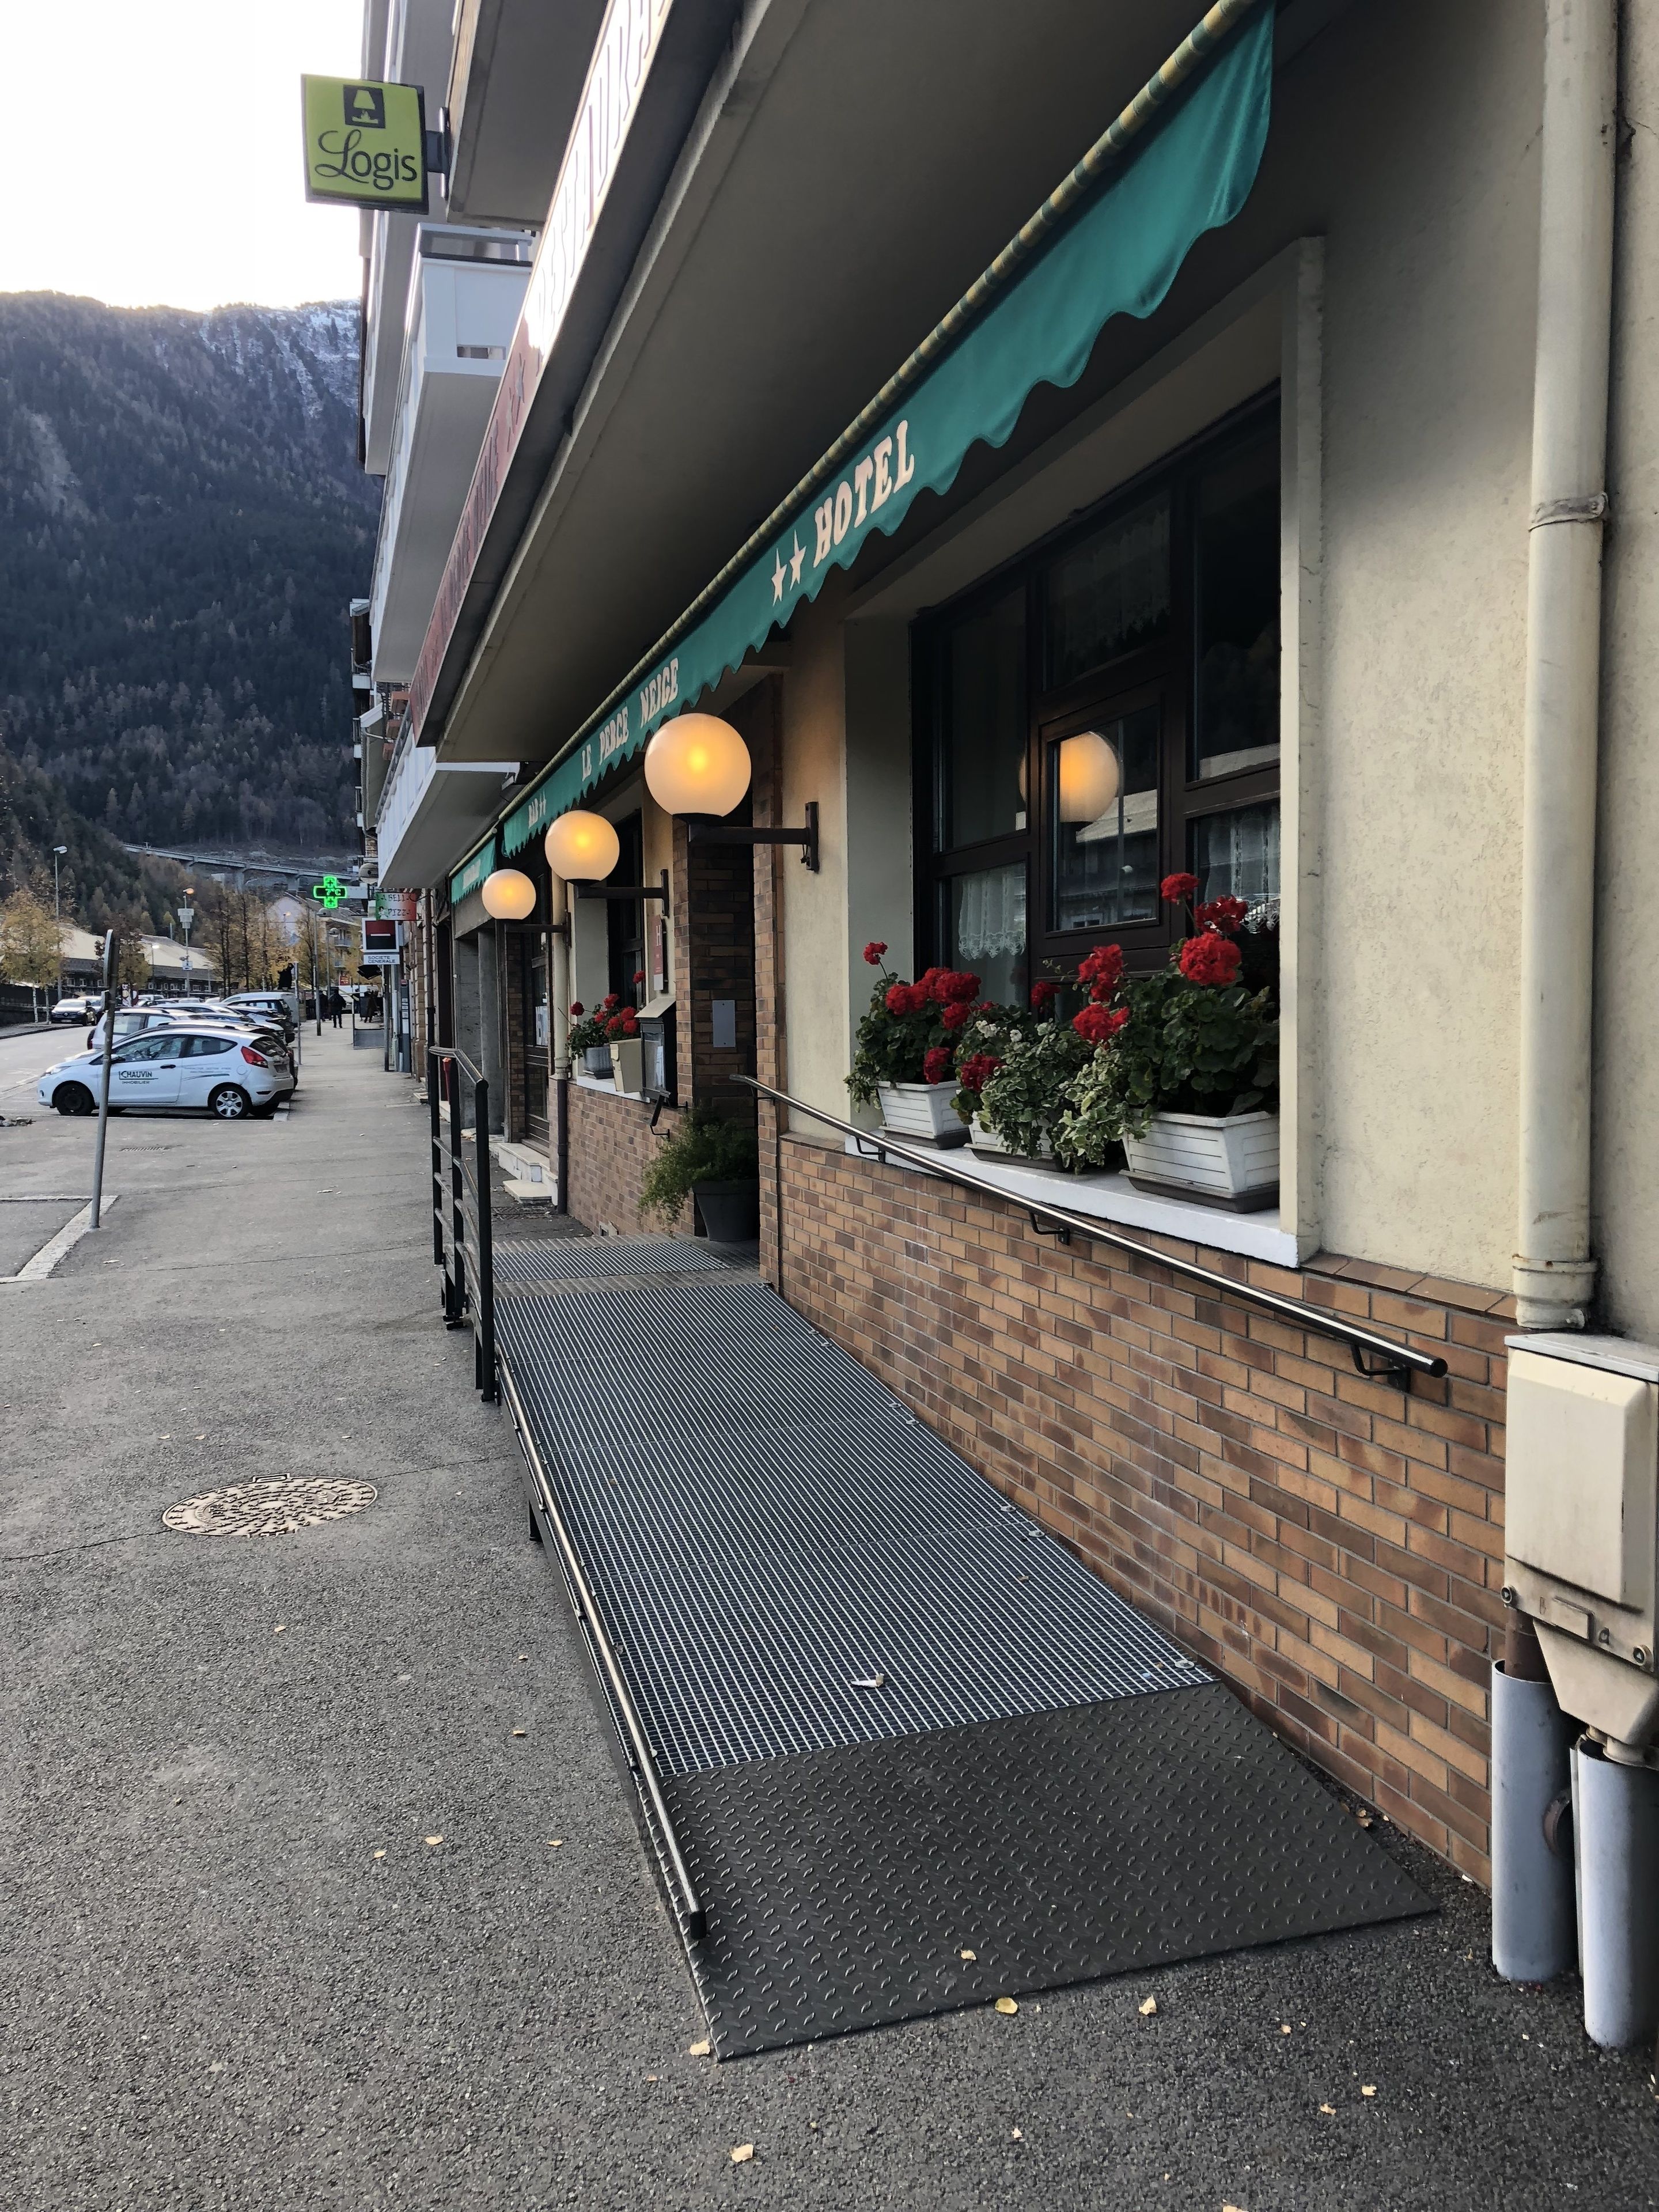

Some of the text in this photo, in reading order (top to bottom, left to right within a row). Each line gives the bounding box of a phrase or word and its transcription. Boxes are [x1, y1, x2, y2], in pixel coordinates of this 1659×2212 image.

[315, 129, 418, 191] Logis
[582, 743, 592, 782] LE
[599, 706, 629, 766] PERCE
[639, 657, 679, 729] NEIGE
[813, 419, 915, 569] HOTEL
[656, 925, 661, 946] H
[121, 1070, 153, 1078] CHAUVIN
